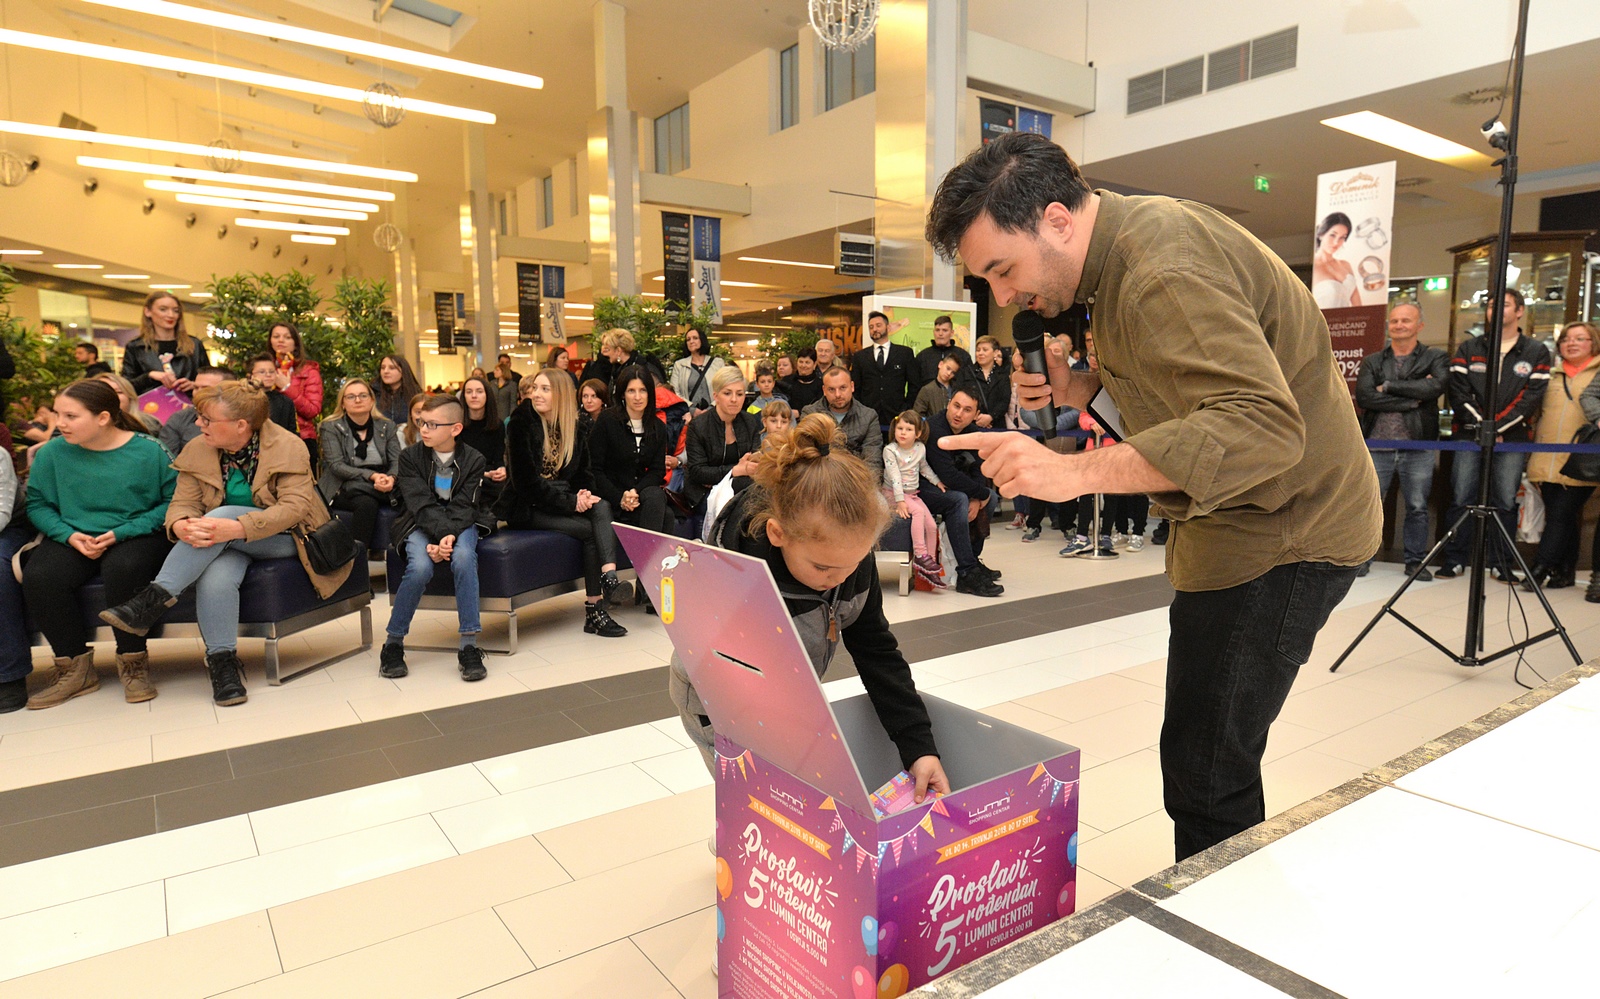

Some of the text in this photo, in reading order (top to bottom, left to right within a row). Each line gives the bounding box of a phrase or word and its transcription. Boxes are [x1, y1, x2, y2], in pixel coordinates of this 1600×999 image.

[1333, 348, 1363, 360] opust
[1338, 360, 1361, 376] 0%
[770, 793, 789, 808] SHOPPING
[969, 805, 1010, 825] SHOPPING CENTAR
[953, 843, 961, 854] DO
[971, 831, 993, 846] TRAVNJA
[1008, 823, 1015, 831] DO
[1015, 820, 1022, 828] 17
[1022, 815, 1034, 826] SATI
[742, 822, 824, 903] Proslavi
[744, 866, 832, 938] 5. rođendan
[927, 849, 1030, 922] Proslavi
[769, 897, 796, 929] LUMINI
[797, 919, 828, 954] CENTRA
[927, 878, 1038, 977] 5. rođendan
[965, 901, 1034, 947] LUMINI CENTRA
[986, 919, 1033, 948] I OSVOJI 5.000 KN
[762, 952, 782, 974] SHOPPING
[789, 930, 806, 950] OSVOJI
[805, 944, 820, 960] 5.000
[820, 954, 828, 967] KN
[763, 963, 782, 986] SHOPPING
